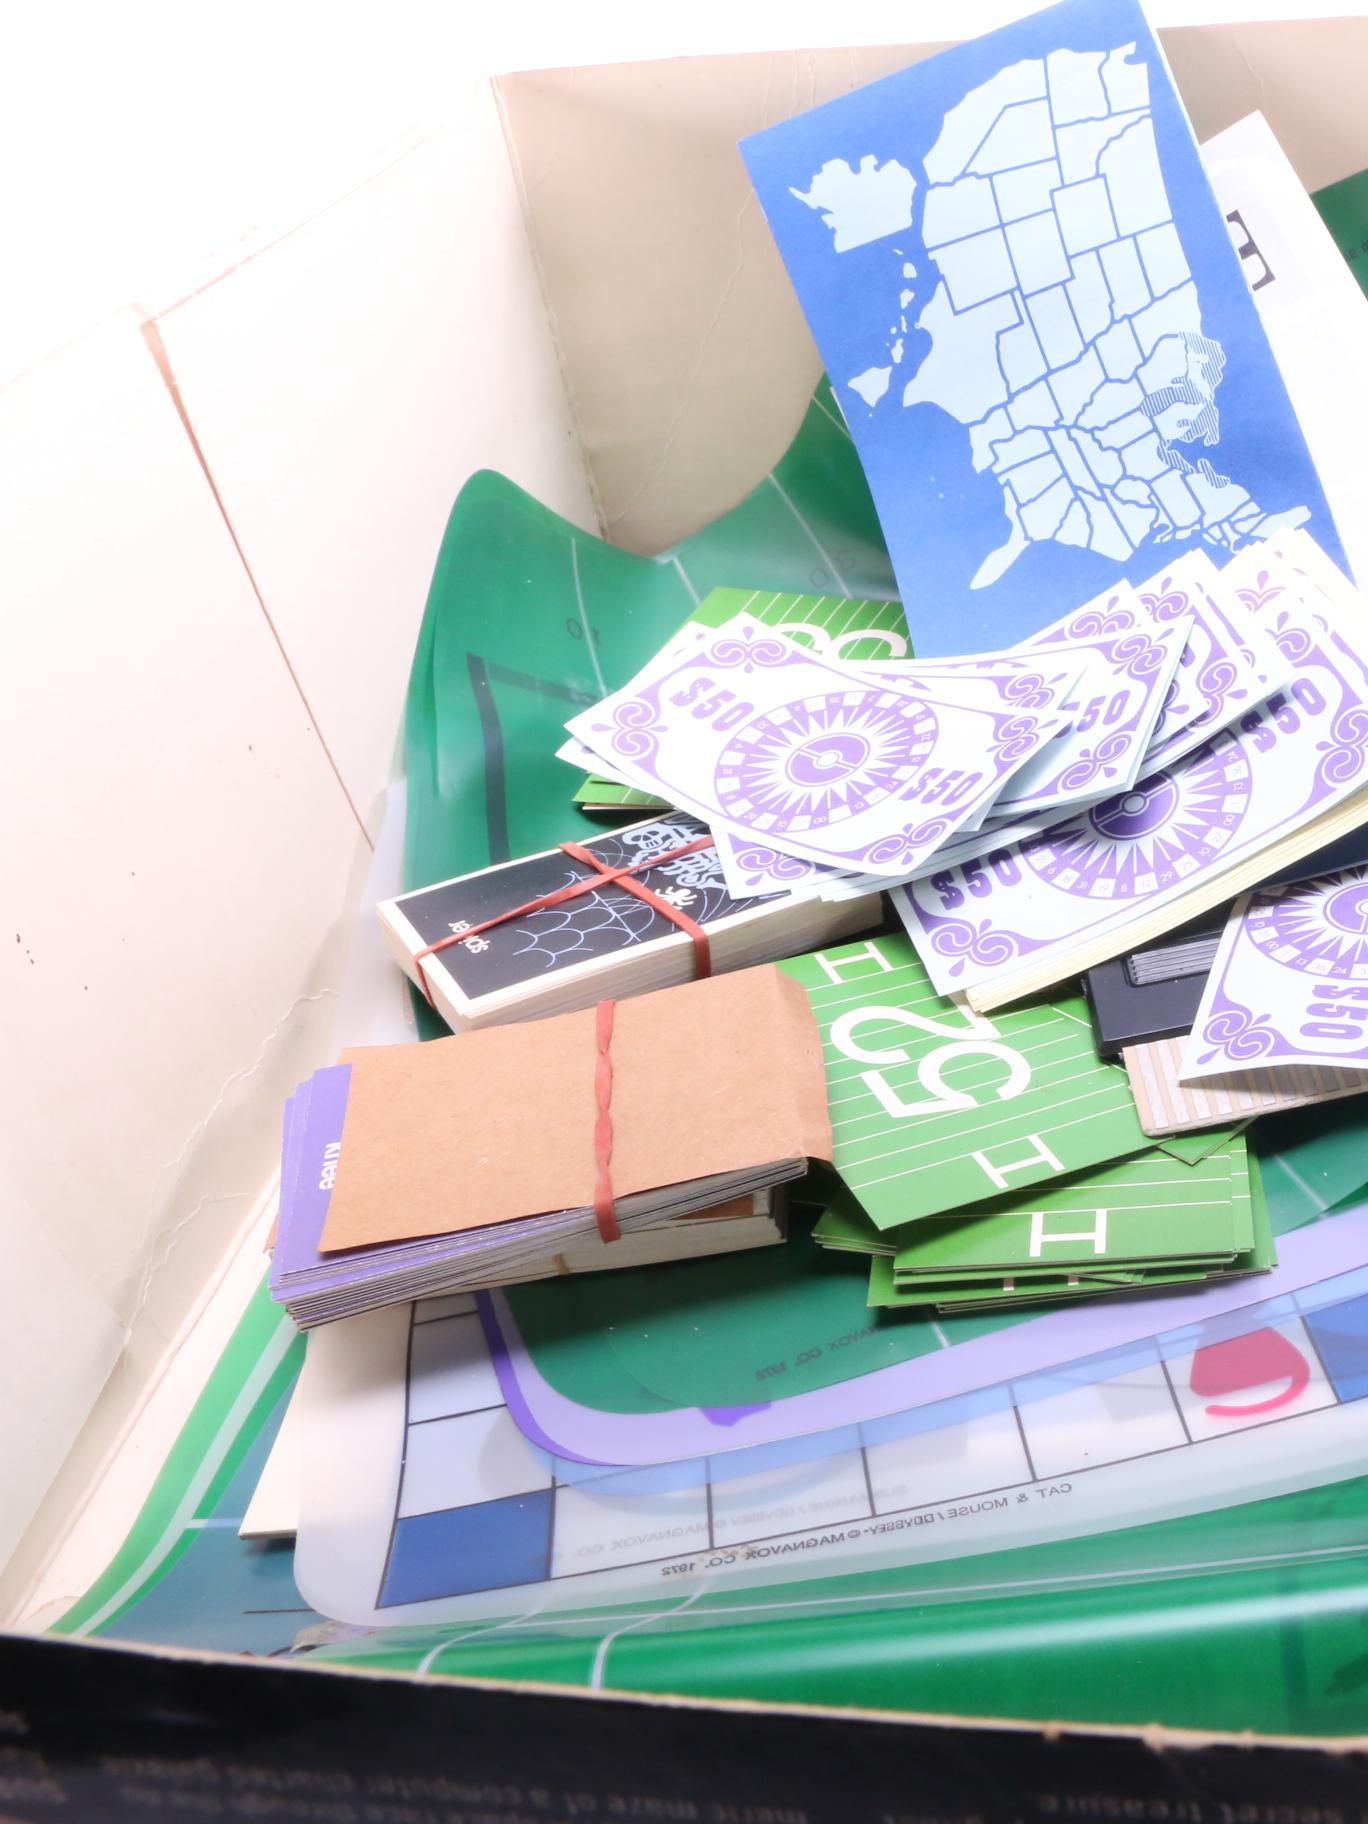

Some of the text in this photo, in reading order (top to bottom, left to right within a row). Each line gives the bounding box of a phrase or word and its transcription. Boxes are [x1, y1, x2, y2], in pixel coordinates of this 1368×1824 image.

[669, 677, 754, 732] $50
[1239, 678, 1327, 755] $50
[899, 767, 984, 807] $50
[931, 849, 1021, 911] $50
[447, 920, 491, 954] spier
